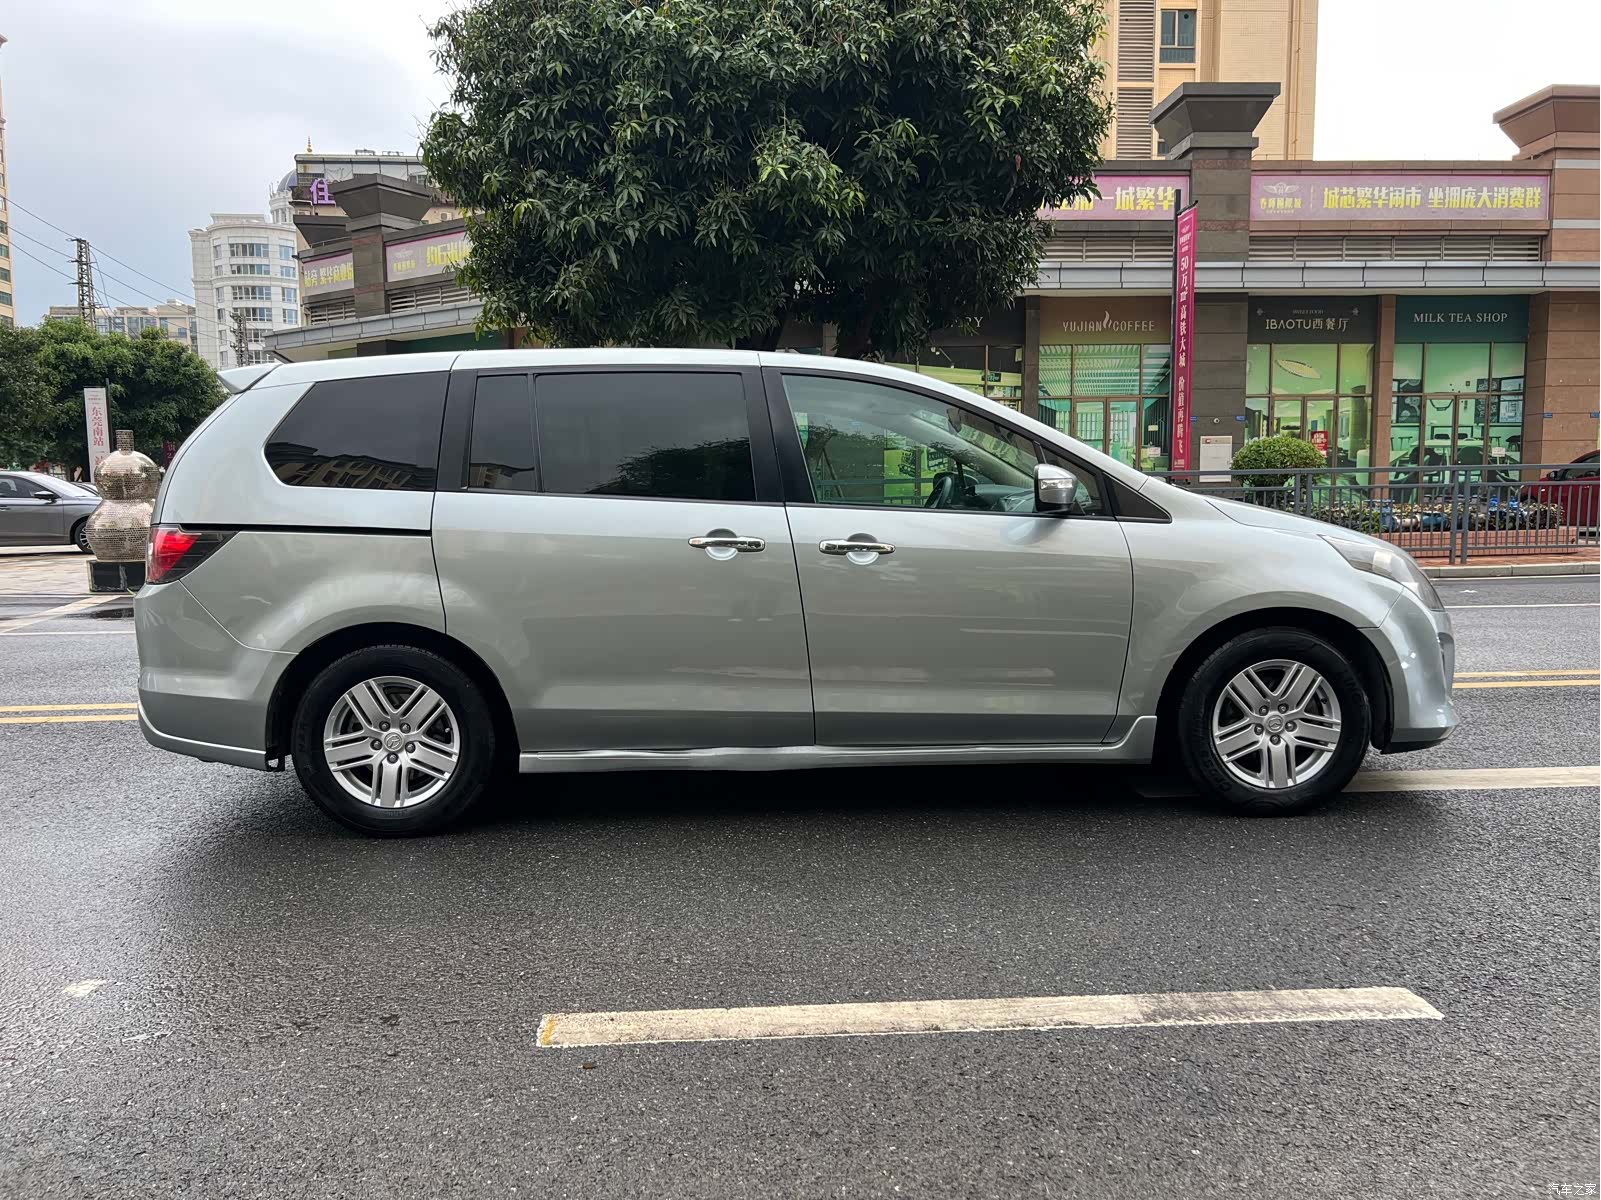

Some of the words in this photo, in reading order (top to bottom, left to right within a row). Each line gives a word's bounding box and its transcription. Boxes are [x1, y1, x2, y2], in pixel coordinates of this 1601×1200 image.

[1413, 313, 1445, 322] MILK
[1449, 313, 1472, 322] TEA
[1476, 313, 1508, 322] SHOP
[1063, 321, 1101, 332] YUJIAN
[1112, 321, 1155, 331] COFFEE
[92, 406, 104, 447] 东莞南站
